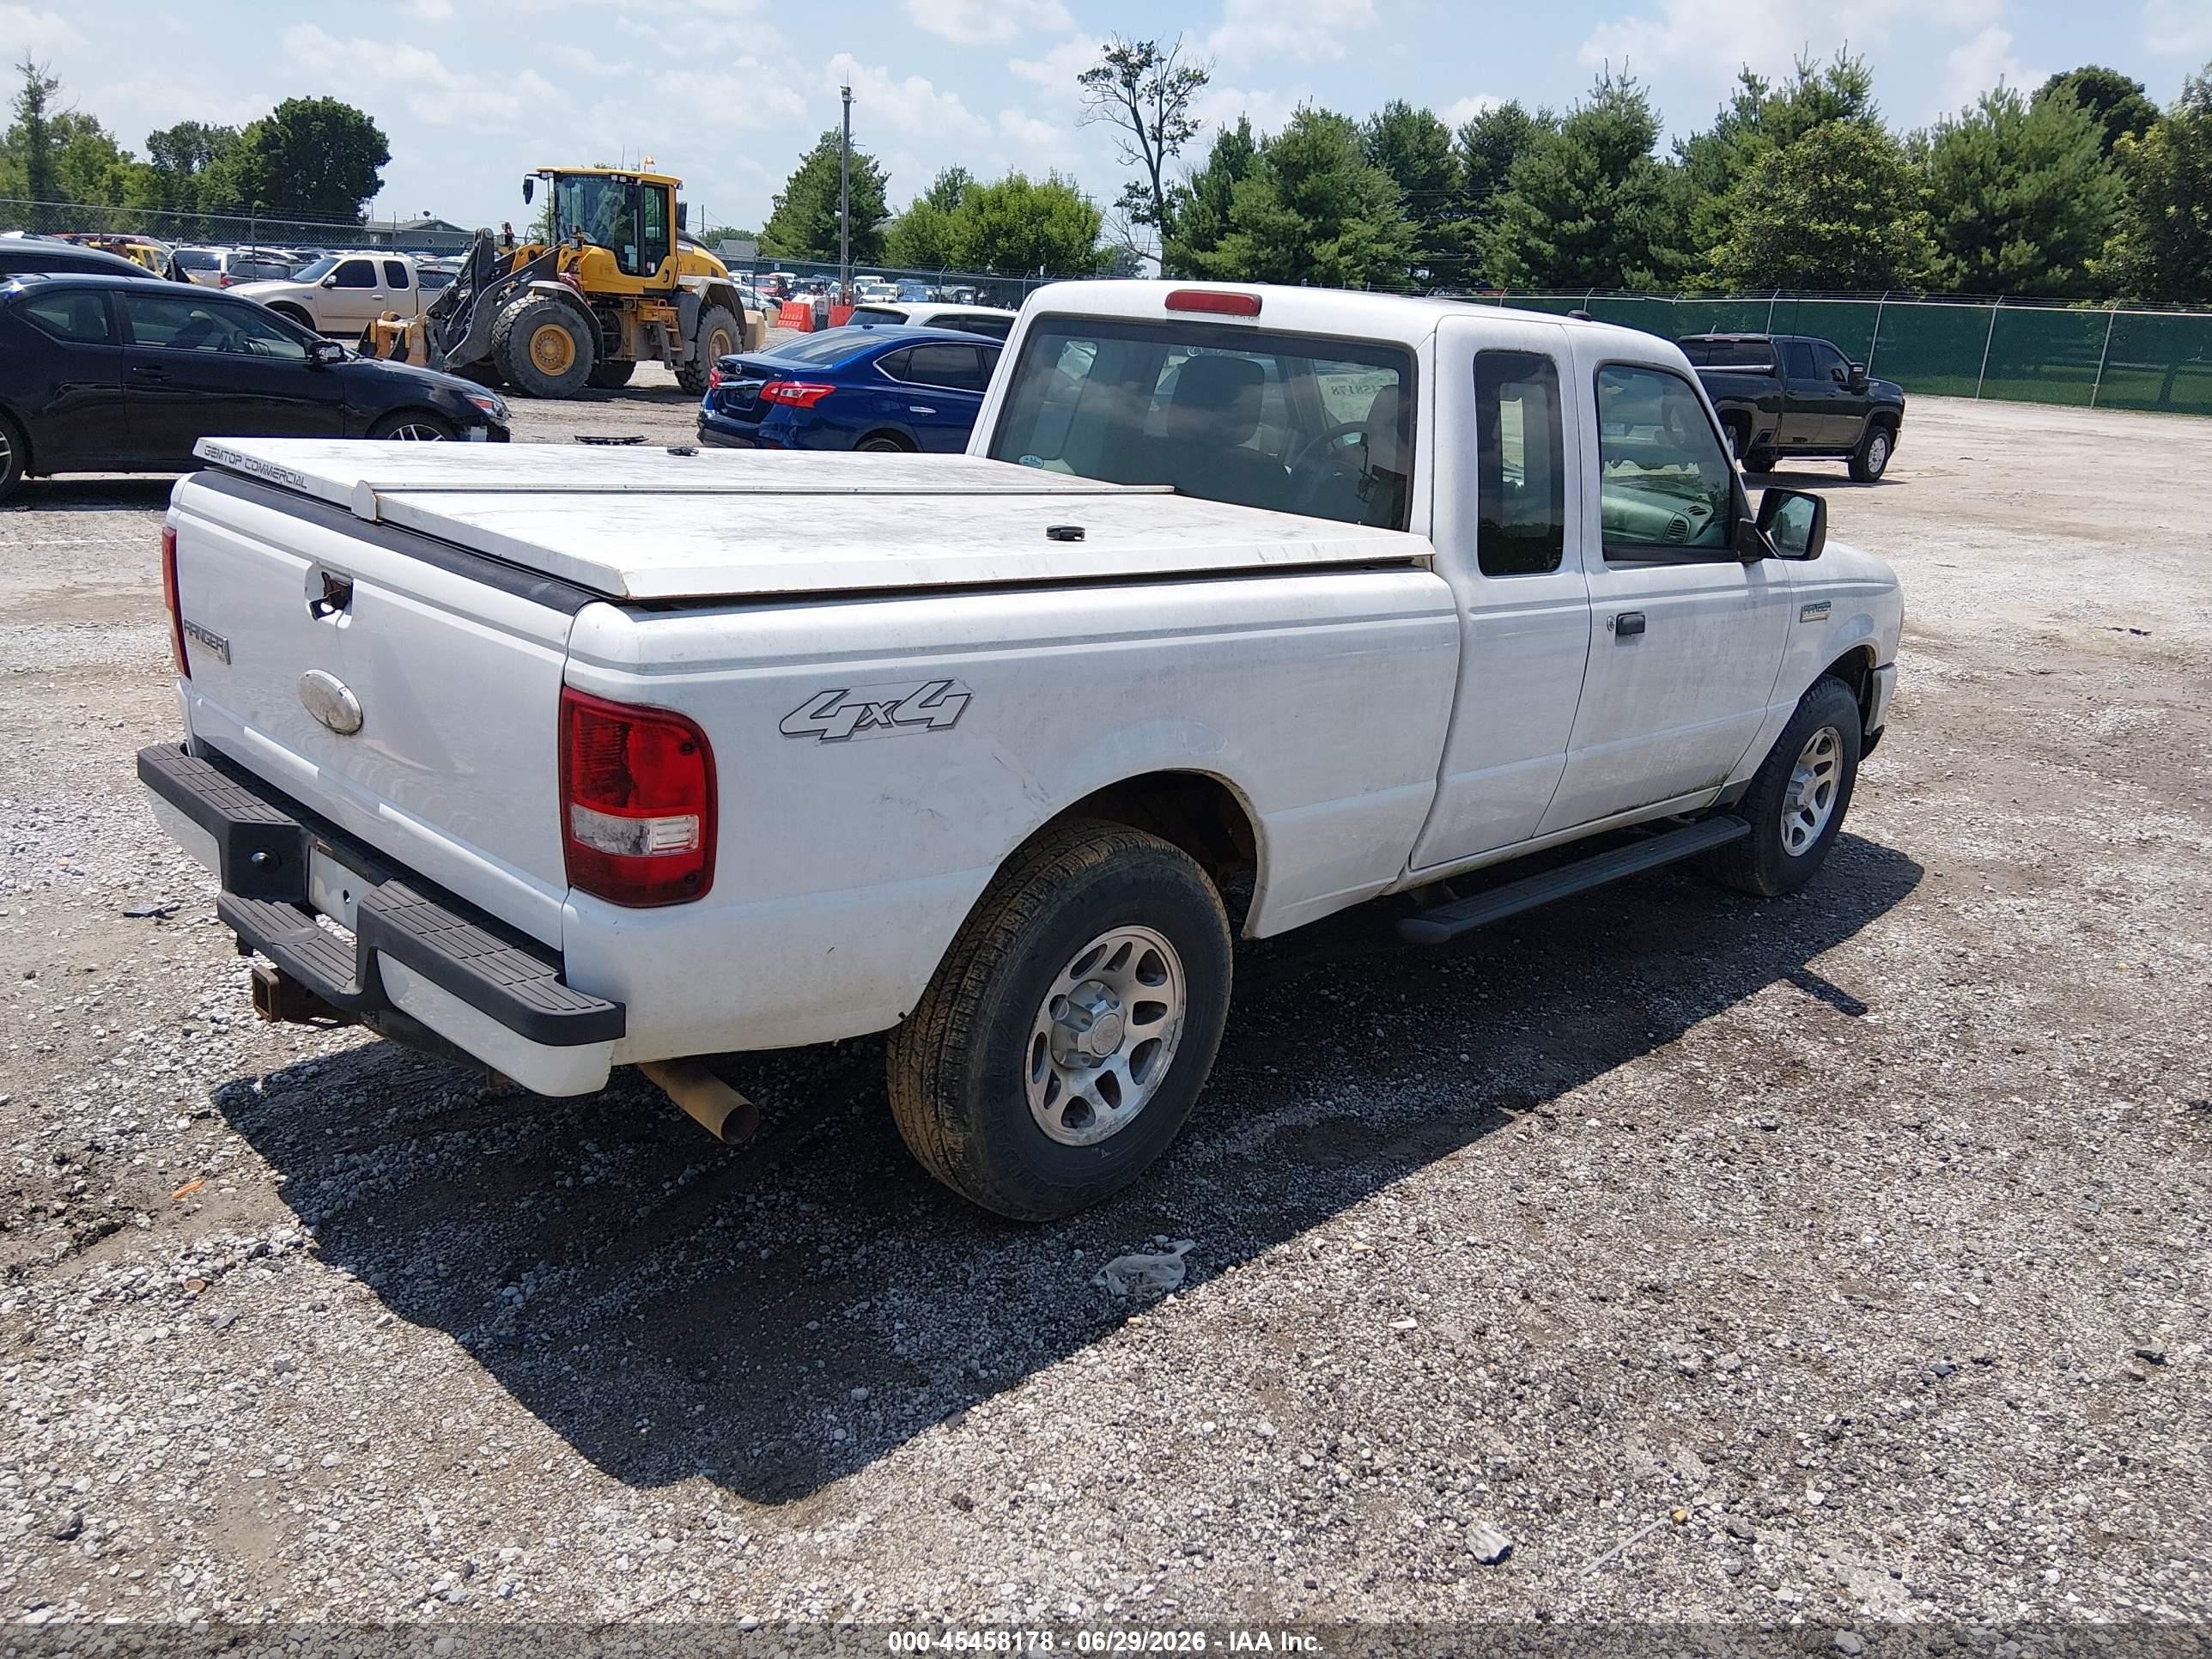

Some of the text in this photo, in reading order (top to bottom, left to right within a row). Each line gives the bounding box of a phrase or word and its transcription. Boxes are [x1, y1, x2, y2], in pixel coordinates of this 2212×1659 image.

[204, 445, 307, 489] GEMTOP COMMERCIAL
[184, 619, 224, 653] RANGER
[779, 678, 973, 743] 4x4
